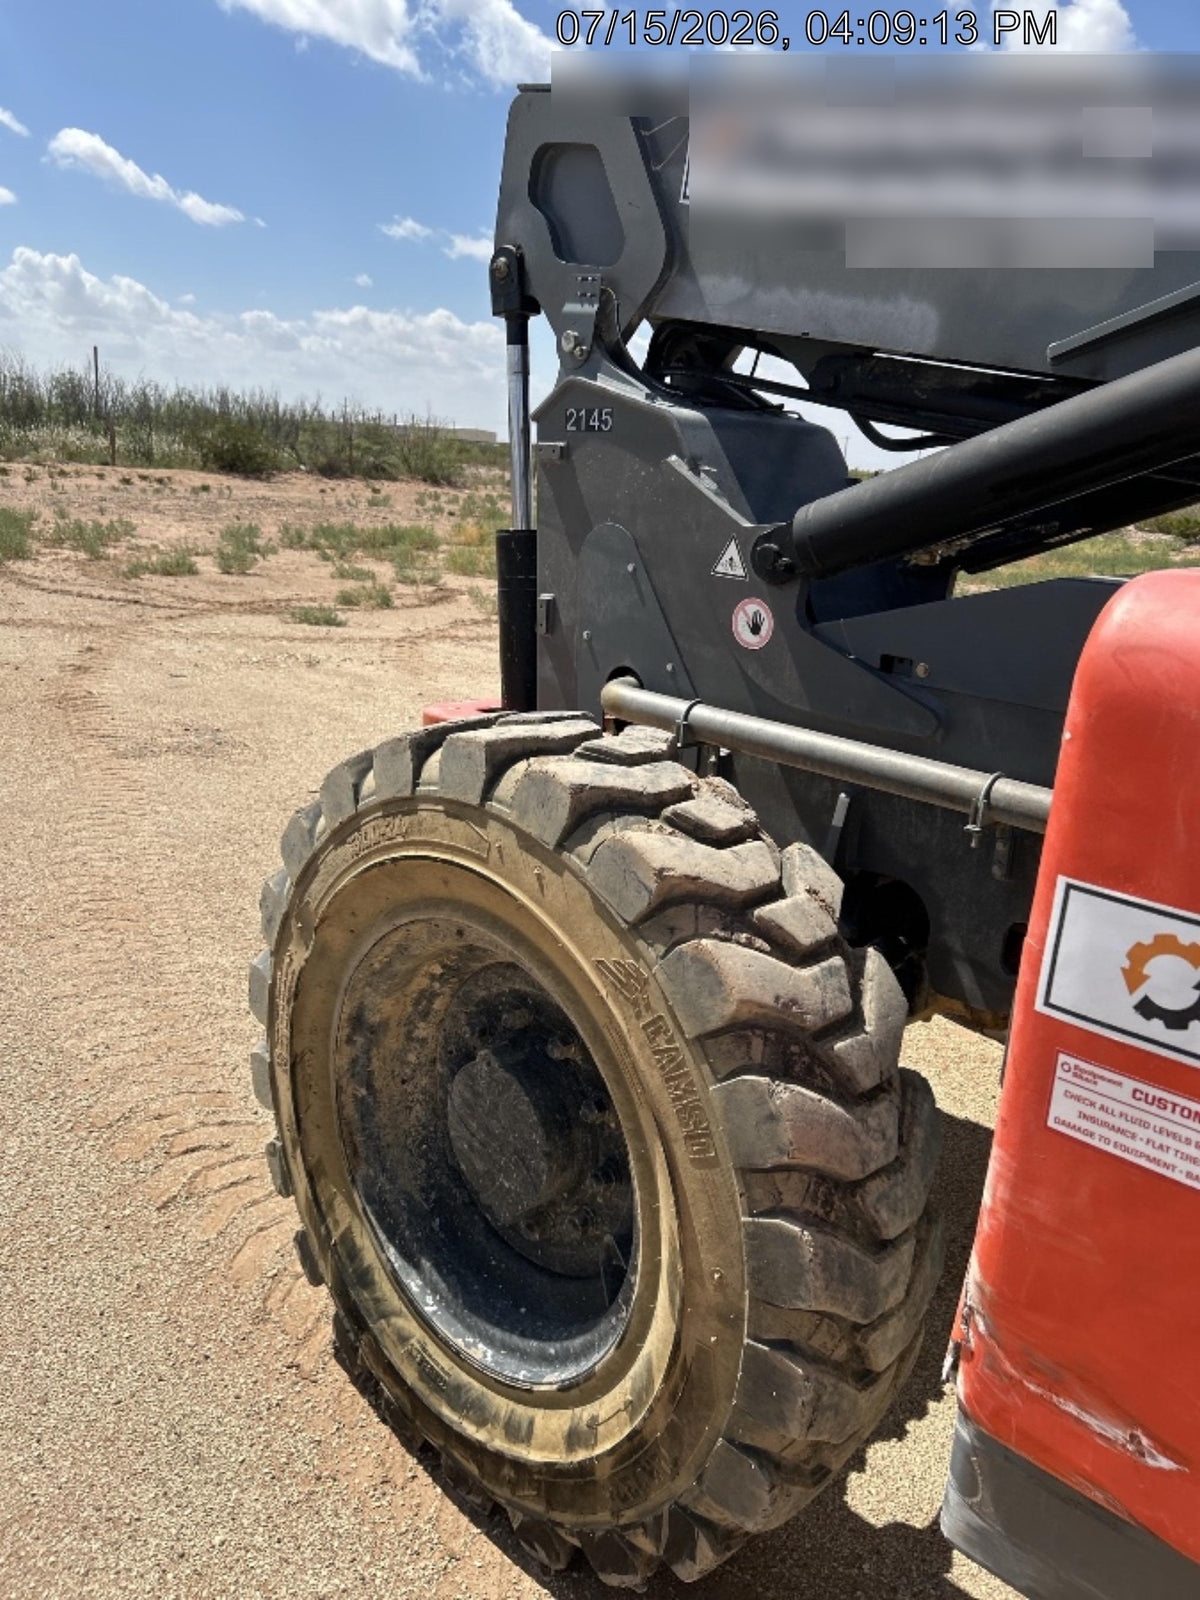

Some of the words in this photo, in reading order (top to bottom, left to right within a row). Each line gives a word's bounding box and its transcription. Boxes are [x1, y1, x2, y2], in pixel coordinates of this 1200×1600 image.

[566, 408, 612, 431] 2145
[640, 1012, 718, 1163] CAMSO
[1053, 1116, 1097, 1139] DAMAGE
[1098, 1134, 1111, 1146] TO
[1113, 1141, 1177, 1173] EQUIPMENT
[1064, 1090, 1097, 1109] CHECK
[1099, 1104, 1116, 1117] ALL
[1119, 1111, 1151, 1130] FLUID
[1153, 1124, 1192, 1146] LEVELS
[1077, 1111, 1137, 1141] INSURANCE
[1145, 1138, 1171, 1154] FLAT
